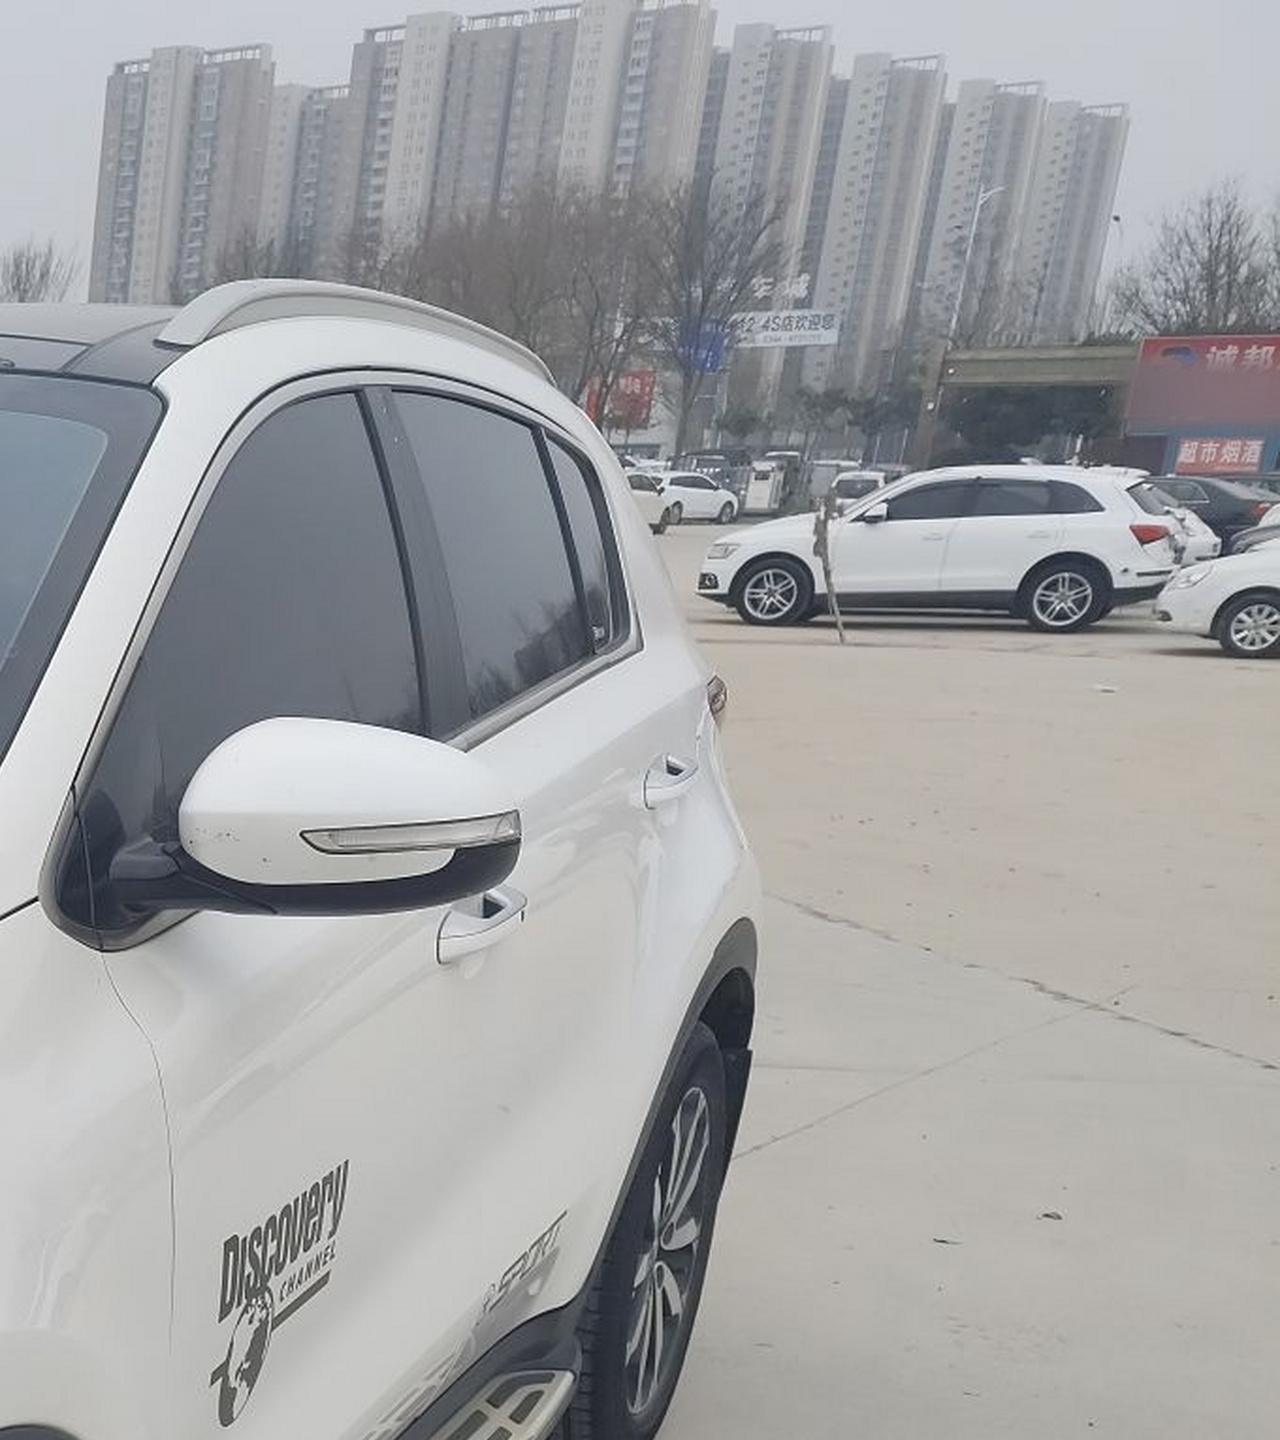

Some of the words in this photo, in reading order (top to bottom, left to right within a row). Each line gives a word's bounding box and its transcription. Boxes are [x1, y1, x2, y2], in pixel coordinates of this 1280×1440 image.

[1178, 439, 1265, 463] 超市烟酒
[278, 1239, 336, 1303] CHANNEL
